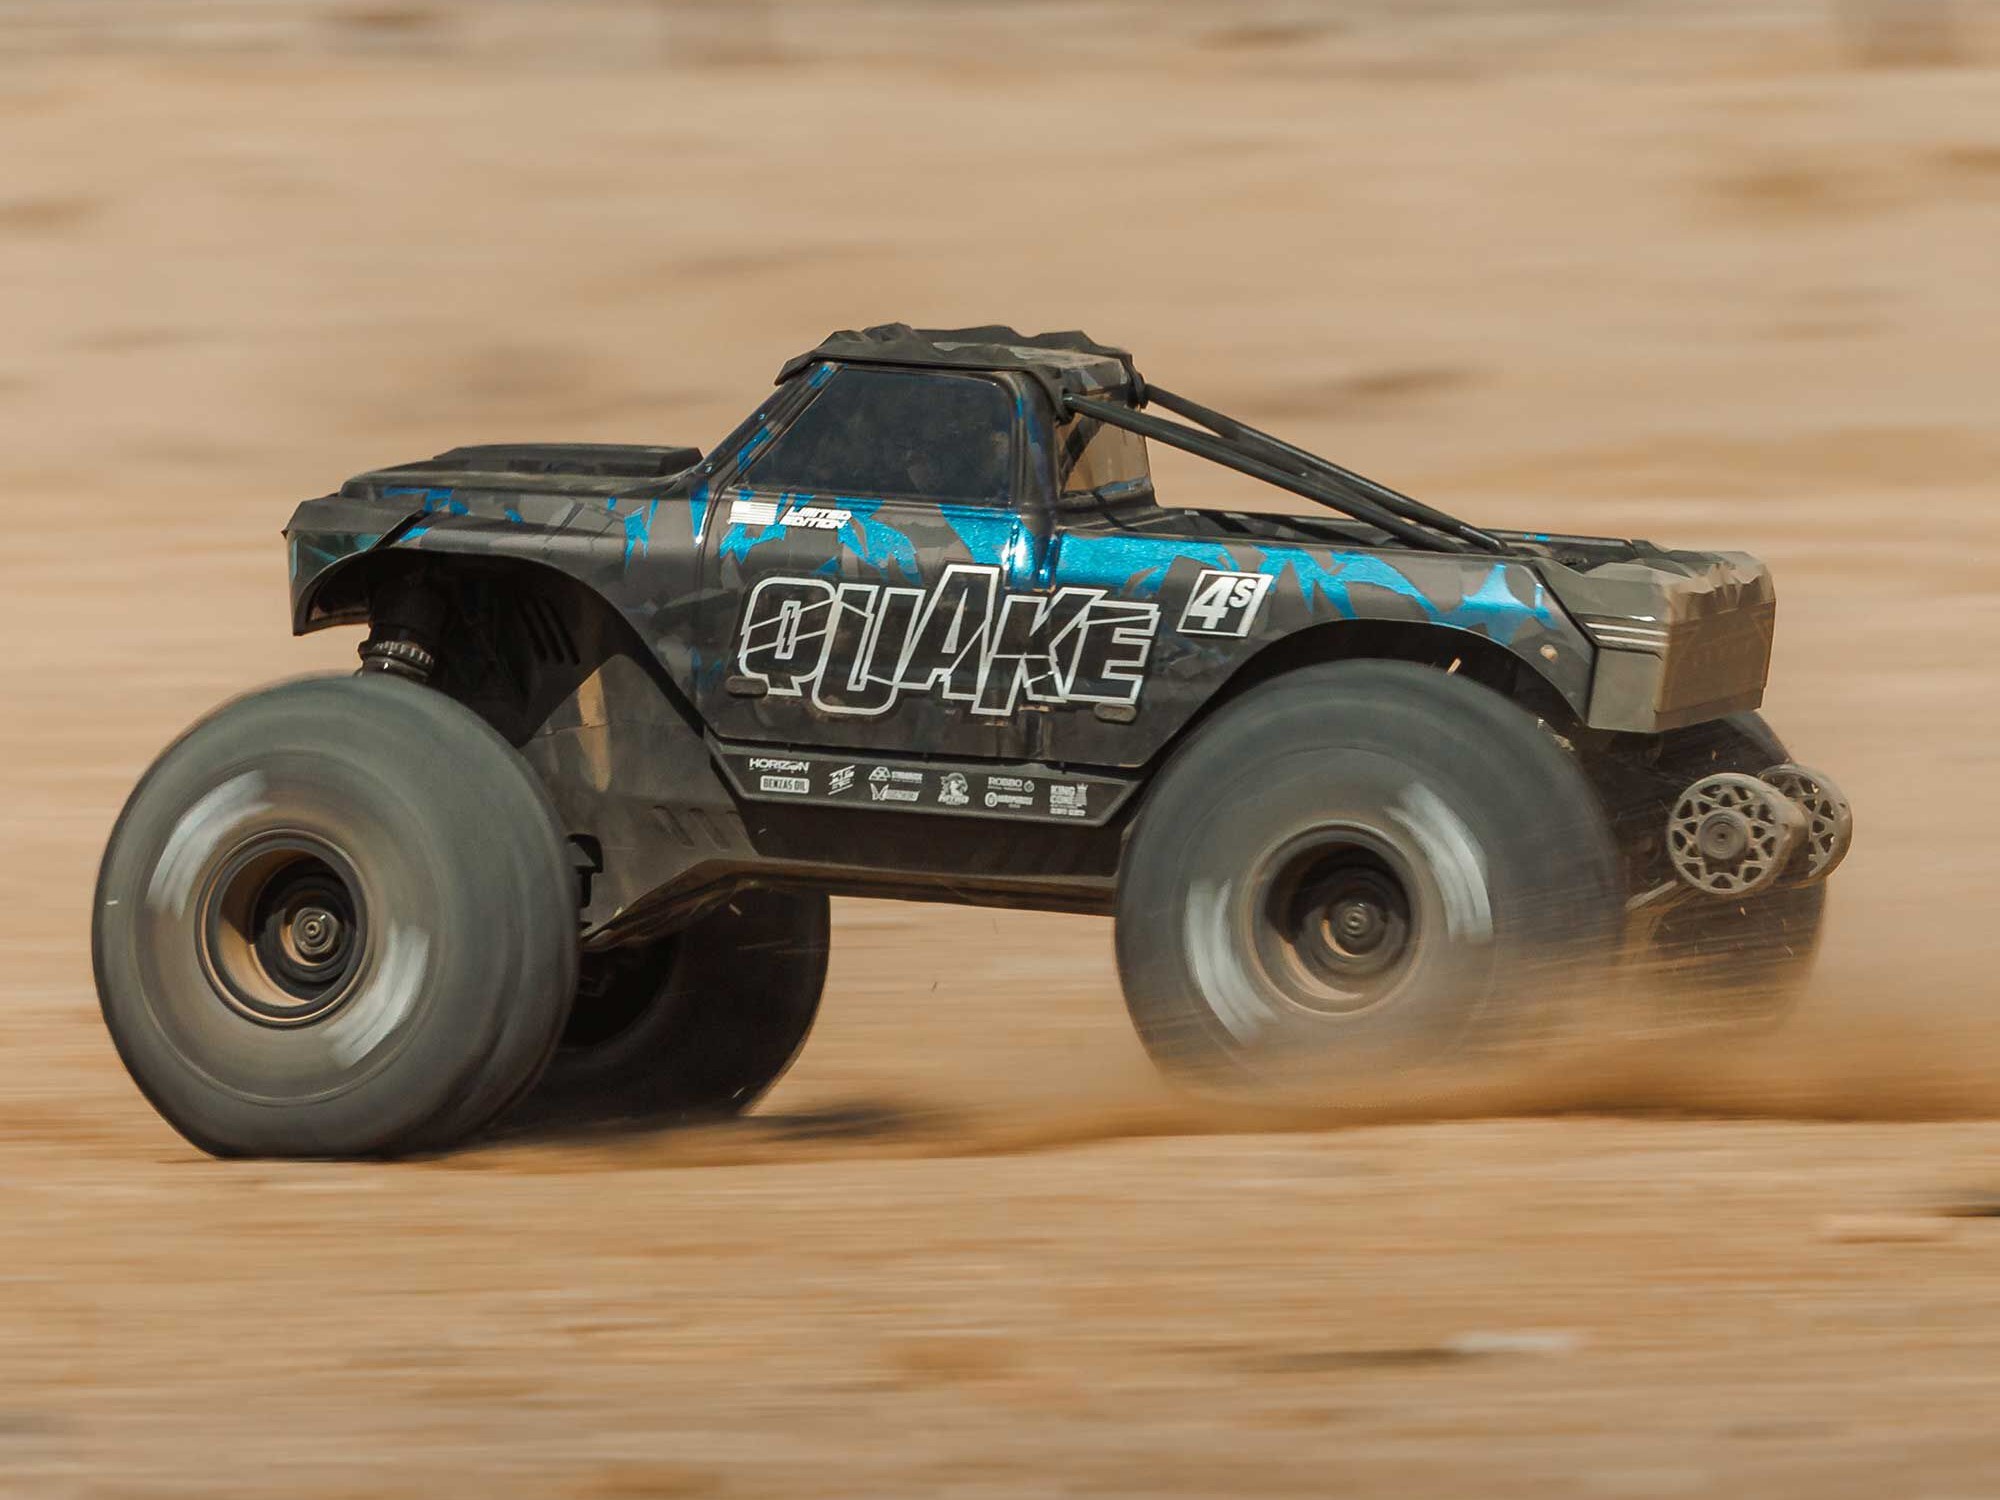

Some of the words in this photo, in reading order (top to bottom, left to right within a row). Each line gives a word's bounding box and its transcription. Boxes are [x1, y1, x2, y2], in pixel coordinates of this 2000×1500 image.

[786, 506, 853, 520] LIMITED
[779, 516, 849, 530] EDITION
[1187, 576, 1257, 630] 4S
[738, 564, 1161, 716] QUAKE
[749, 758, 811, 771] HORIZON
